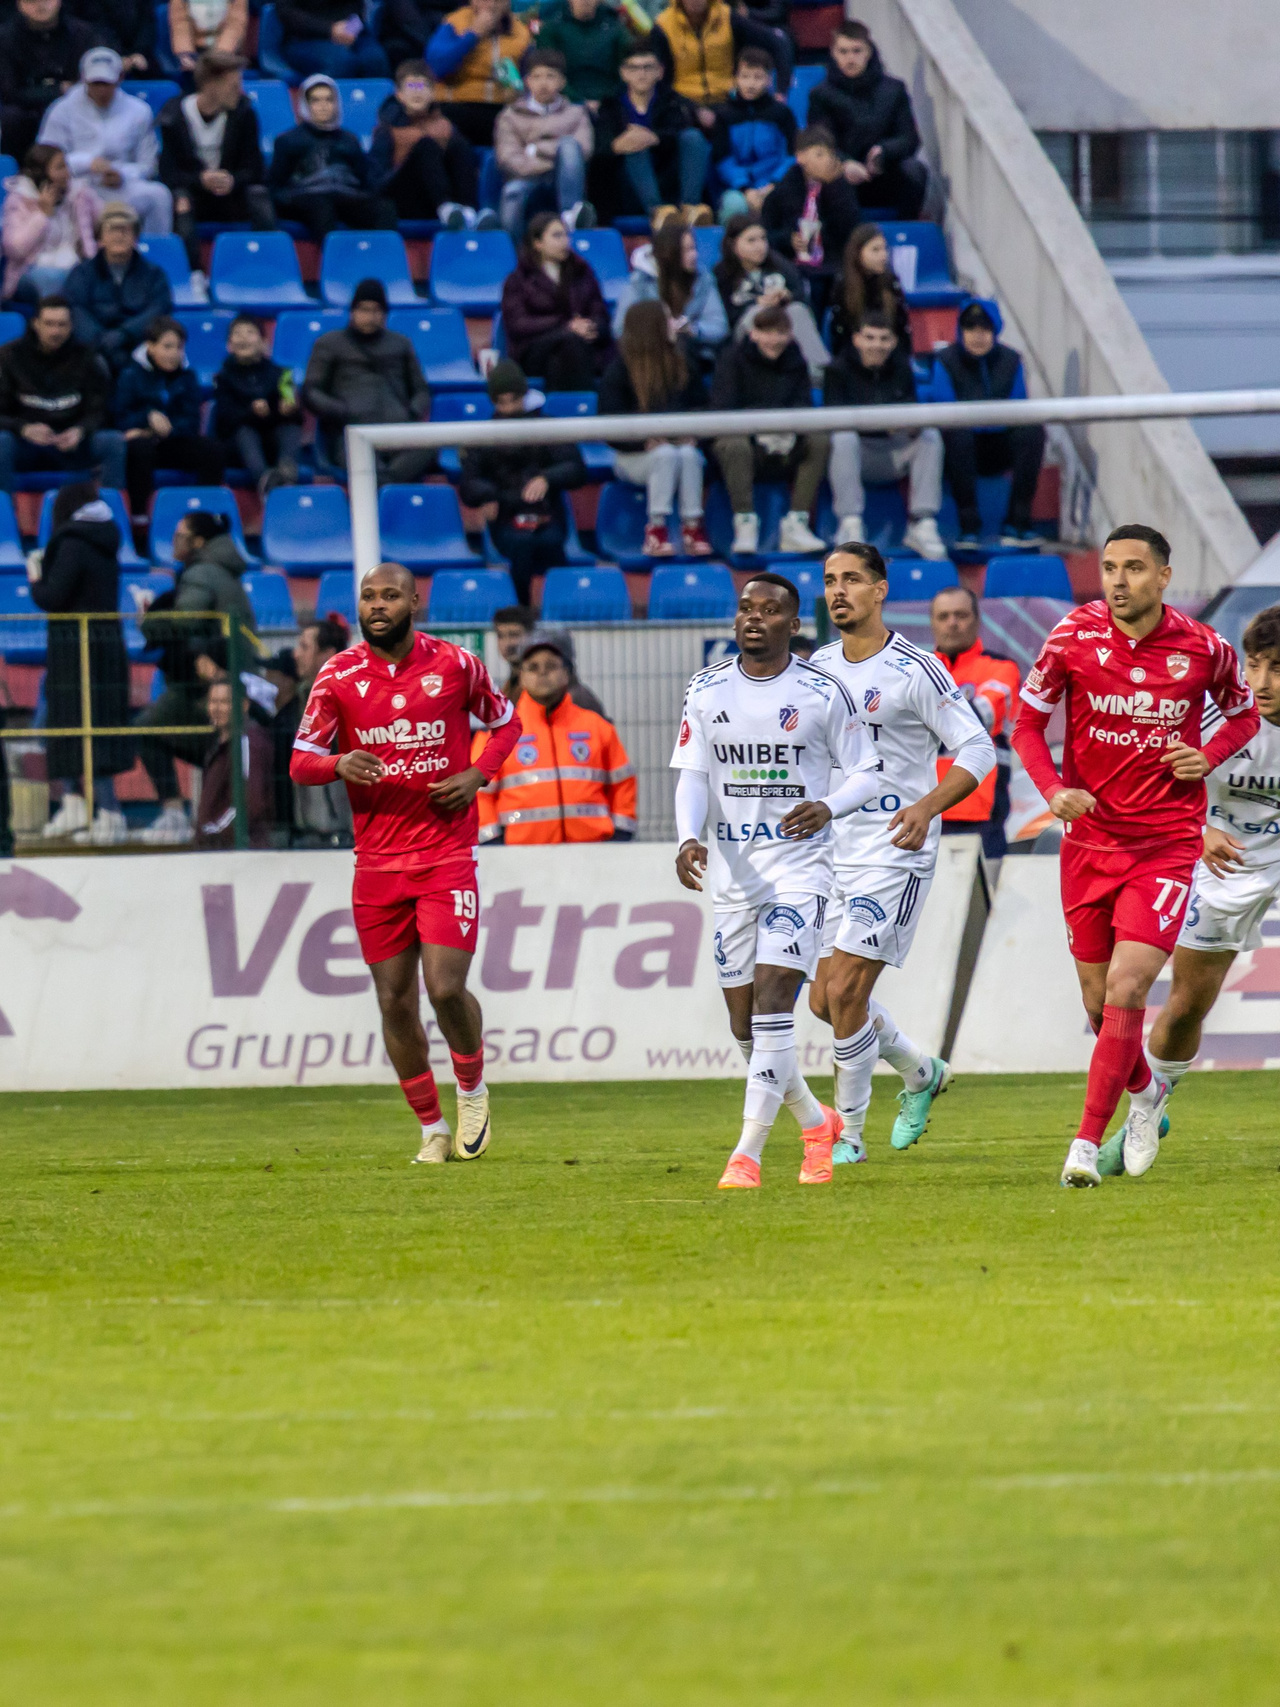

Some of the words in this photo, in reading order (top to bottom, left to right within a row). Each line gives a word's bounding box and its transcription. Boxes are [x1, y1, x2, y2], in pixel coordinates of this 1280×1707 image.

[1087, 691, 1191, 719] WIN2.RO
[354, 718, 446, 745] WIN2.RO
[714, 744, 806, 765] UNIBET
[762, 786, 784, 797] SPRE
[785, 787, 800, 797] 0%
[1228, 773, 1280, 790] UNI
[450, 890, 476, 919] 19
[1152, 877, 1189, 917] 77
[201, 882, 705, 998] Vetra
[424, 1019, 617, 1067] Esaco
